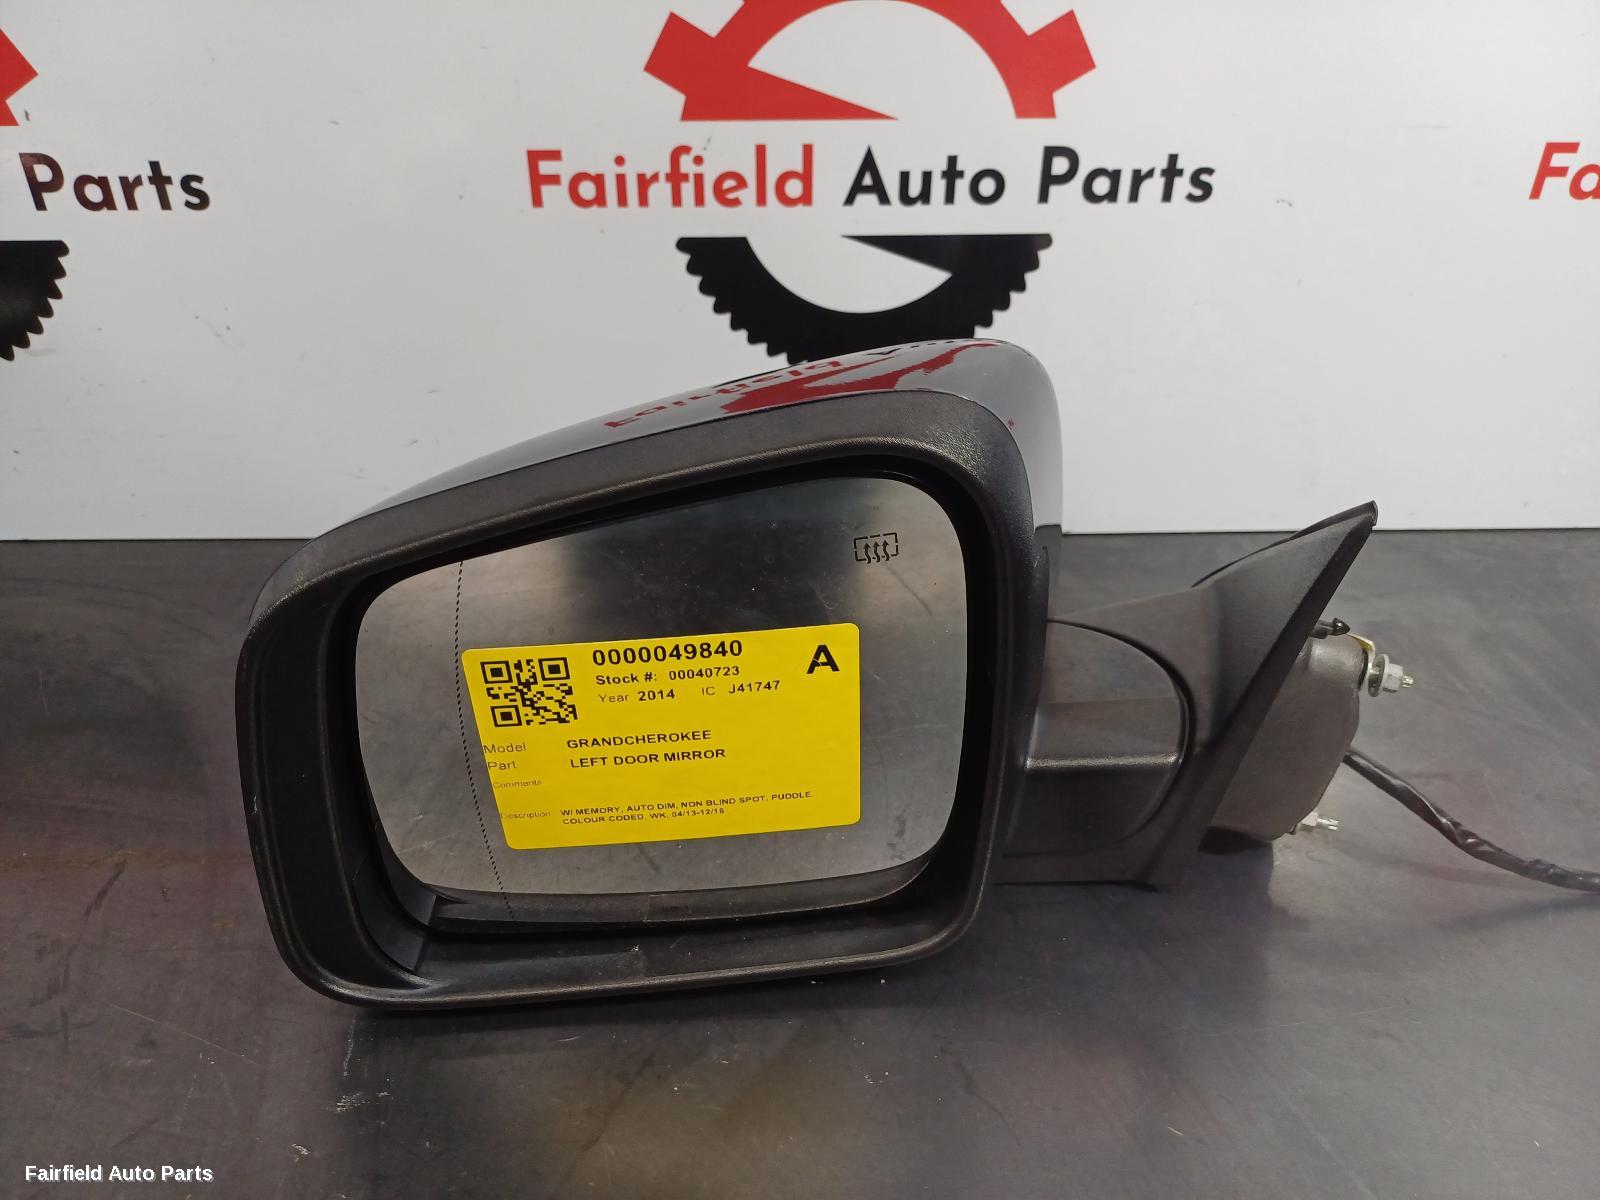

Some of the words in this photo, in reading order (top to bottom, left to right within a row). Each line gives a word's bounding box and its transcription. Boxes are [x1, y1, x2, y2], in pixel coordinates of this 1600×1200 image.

[18, 152, 211, 212] Parts
[526, 144, 814, 208] Fairfield
[842, 145, 1006, 207] Auto
[1036, 146, 1216, 204] Parts
[592, 639, 742, 666] 0000049840
[806, 644, 841, 675] A
[595, 673, 639, 686] Stock
[668, 665, 740, 681] 00040723
[598, 692, 630, 704] Year
[637, 688, 676, 702] 2014
[701, 686, 717, 696] IC
[728, 680, 781, 695] J41747
[483, 741, 527, 755] Model
[566, 729, 713, 750] GRANDCHEROKEE
[487, 760, 517, 771] Part
[570, 756, 609, 769] LEFT
[613, 752, 660, 766] DOOR
[663, 748, 727, 763] MIRROR
[626, 803, 655, 813] AUTO
[680, 800, 703, 809] NON
[705, 796, 736, 807] BLIND
[562, 815, 607, 825] COLOUR
